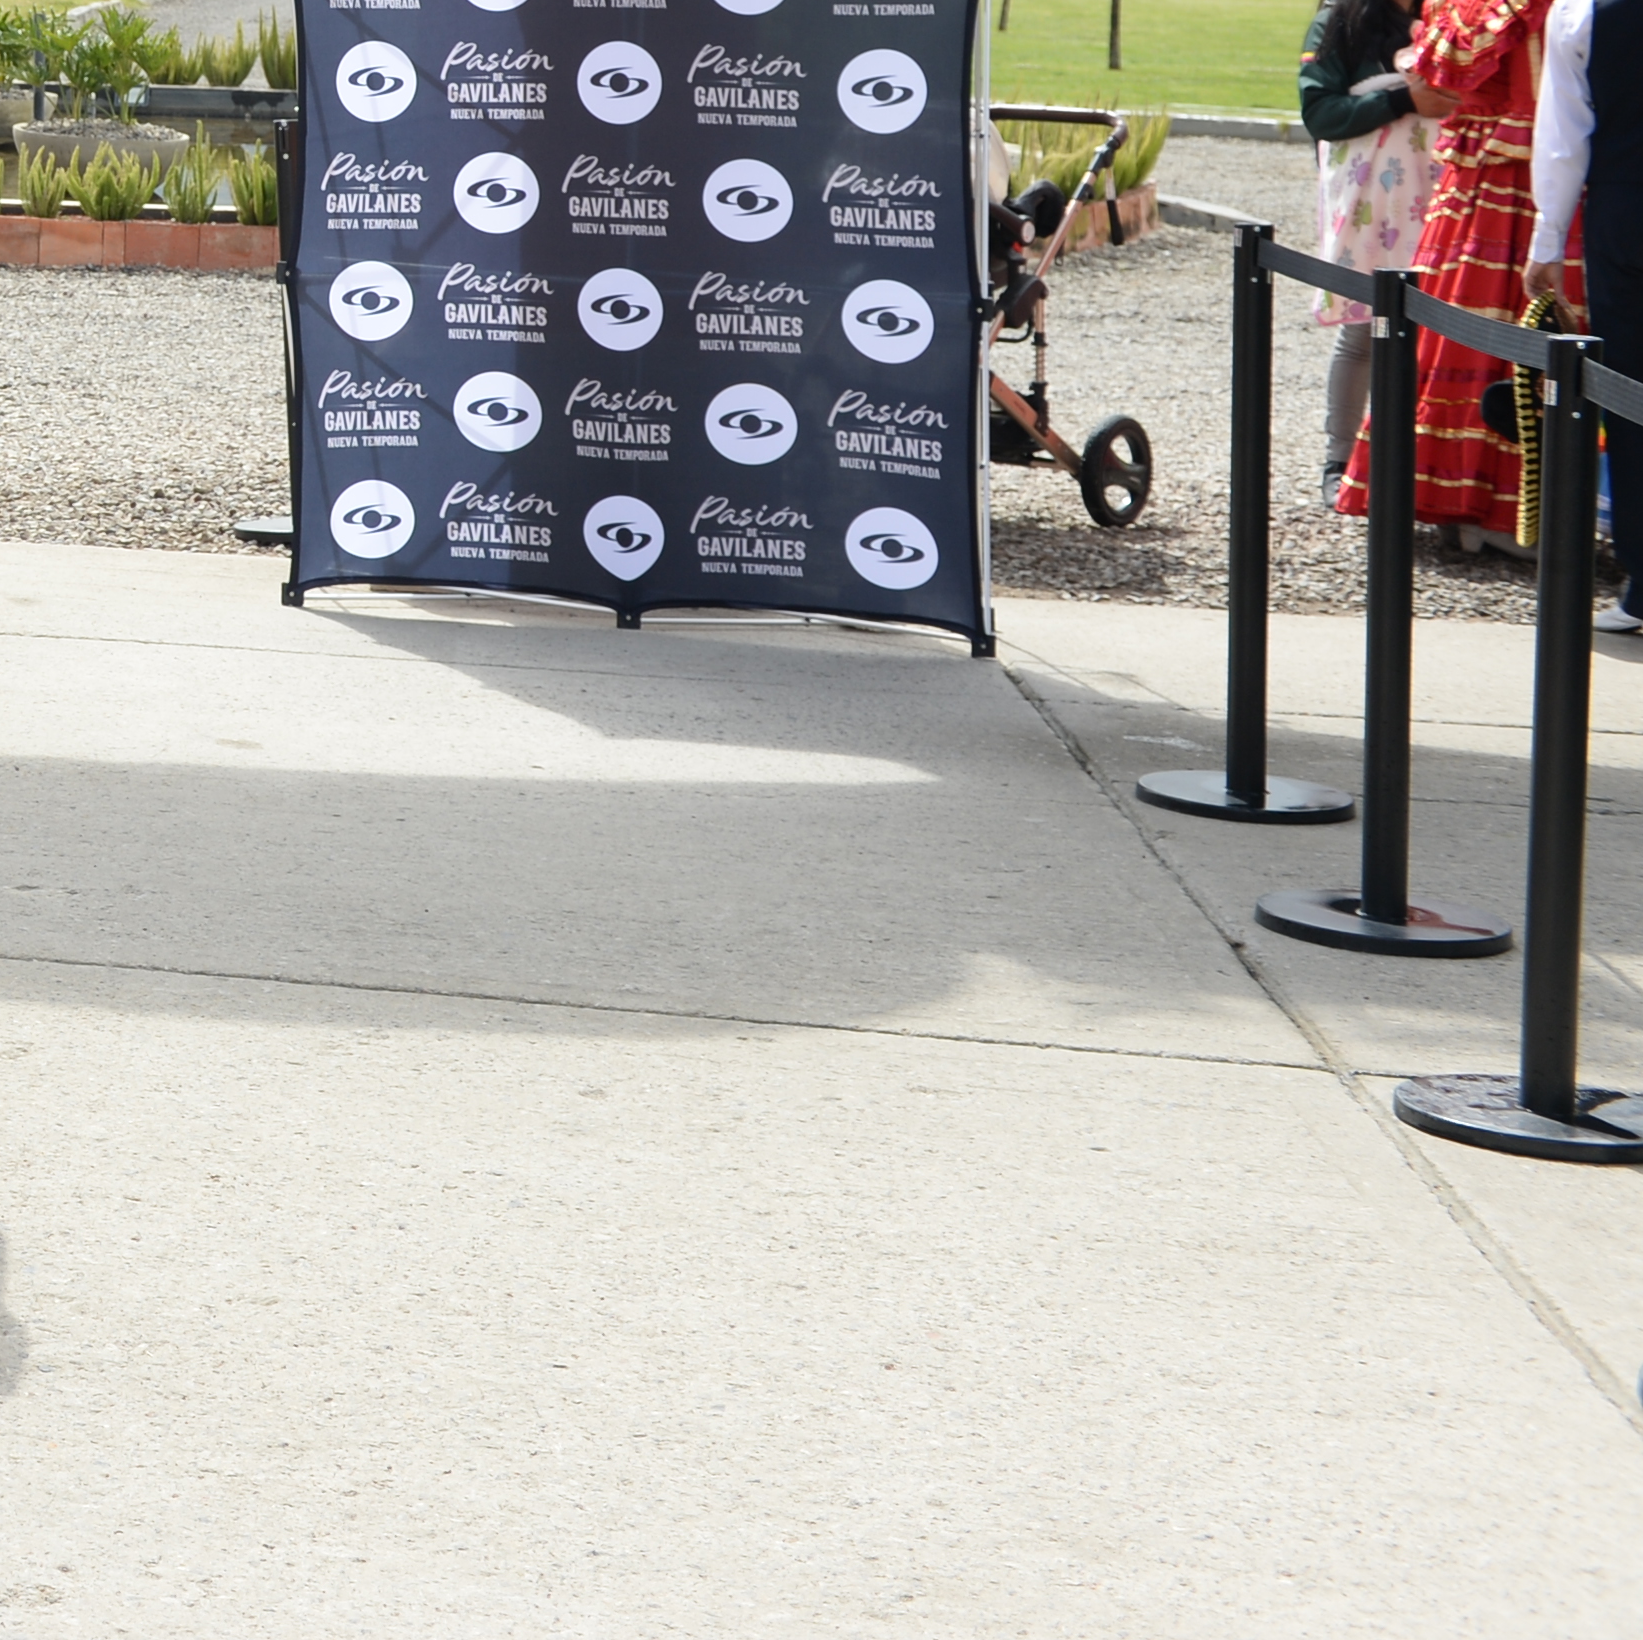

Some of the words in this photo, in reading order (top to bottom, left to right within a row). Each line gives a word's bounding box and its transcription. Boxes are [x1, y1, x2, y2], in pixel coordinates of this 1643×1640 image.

[833, 4, 869, 15] NUEVA
[874, 4, 935, 15] TEMPORADA
[441, 42, 553, 80] Pasión
[687, 44, 806, 83] Pasión
[448, 83, 547, 102] GAVILANES
[695, 86, 799, 110] GAVILANES
[451, 109, 483, 119] NUEVA
[487, 109, 544, 119] TEMPORADA
[698, 113, 732, 124] NUEVA
[737, 114, 797, 127] TEMPORADA
[321, 152, 428, 190] Pasión
[562, 154, 675, 193] Pasión
[822, 164, 941, 202] Pasión
[327, 194, 421, 213] GAVILANES
[569, 196, 669, 219] GAVILANES
[328, 219, 359, 229] NUEVA
[363, 219, 418, 229] TEMPORADA
[573, 223, 605, 234] NUEVA
[610, 224, 667, 236] TEMPORADA
[830, 206, 935, 230] GAVILANES
[834, 233, 870, 245] NUEVA
[874, 235, 934, 248] TEMPORADA
[437, 262, 553, 300] Pasión
[689, 271, 809, 310] Pasión
[445, 303, 547, 326] GAVILANES
[696, 313, 803, 336] GAVILANES
[449, 329, 482, 340] NUEVA
[487, 330, 545, 342] TEMPORADA
[700, 340, 734, 350] NUEVA
[739, 340, 801, 353] TEMPORADA
[318, 370, 427, 408] Pasión
[565, 378, 677, 415] Pasión
[325, 410, 420, 431] GAVILANES
[827, 390, 948, 428] Pasión
[328, 437, 358, 448] NUEVA
[362, 436, 418, 446] TEMPORADA
[573, 419, 671, 444] GAVILANES
[577, 446, 609, 458] NUEVA
[614, 449, 668, 461] TEMPORADA
[836, 430, 942, 462] GAVILANES
[840, 457, 875, 470] NUEVA
[881, 461, 940, 479] TEMPORADA
[439, 481, 557, 518] Pasión
[690, 496, 813, 534] Pasión
[447, 522, 551, 546] GAVILANES
[451, 547, 485, 558] NUEVA
[489, 548, 549, 562] TEMPORADA
[698, 536, 805, 560] GAVILANES
[702, 562, 737, 573] NUEVA
[742, 564, 803, 576] TEMPORADA
